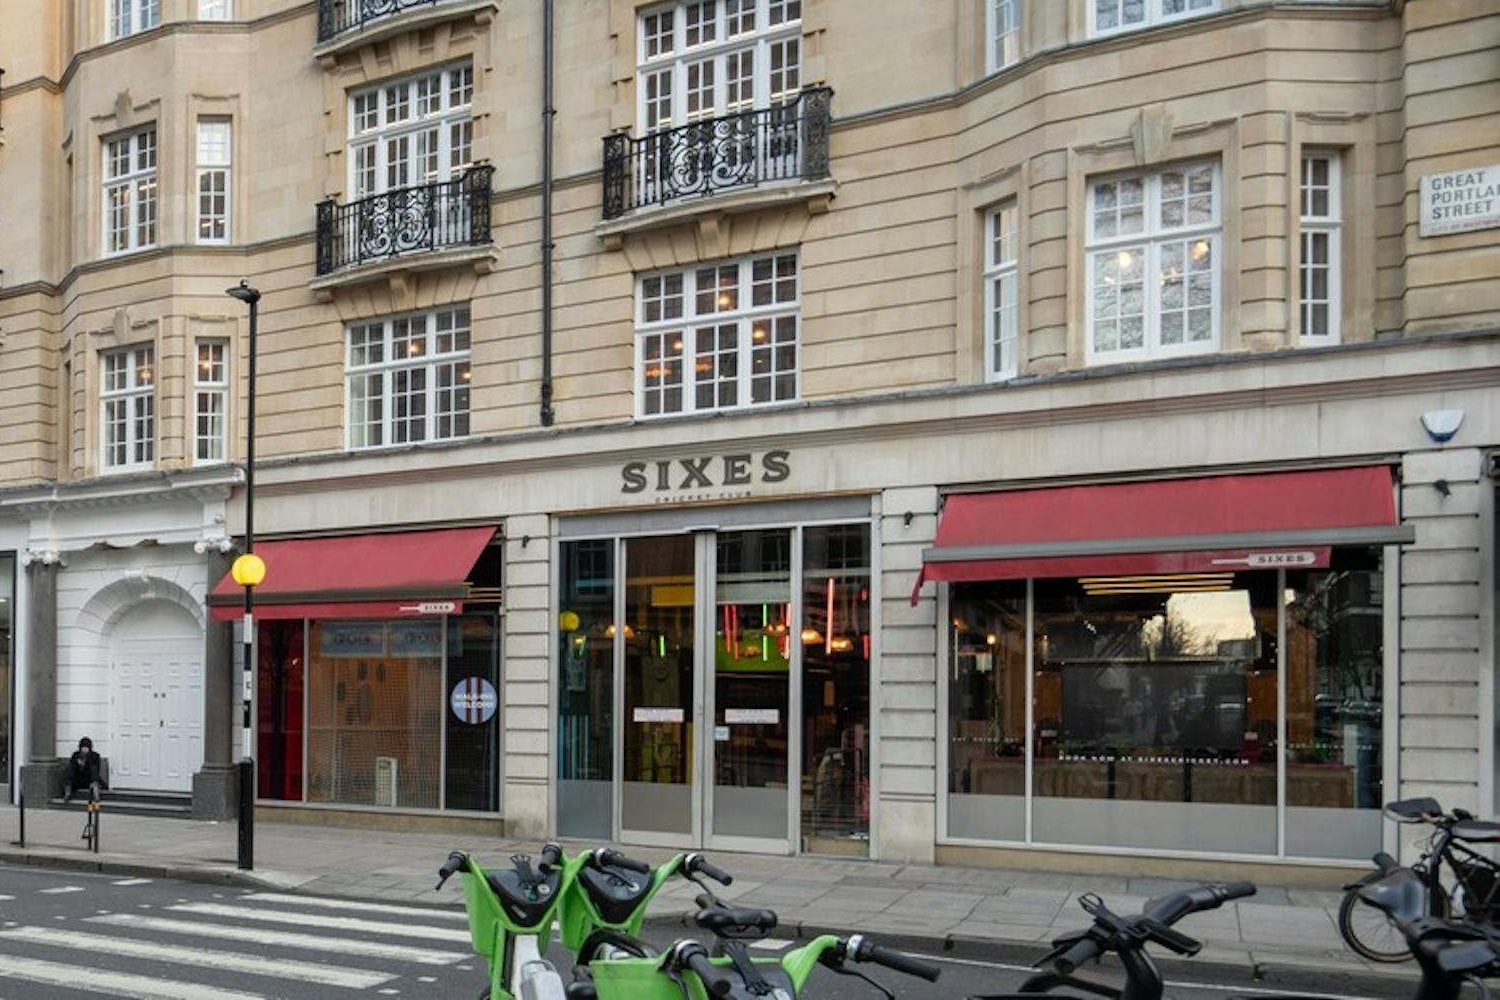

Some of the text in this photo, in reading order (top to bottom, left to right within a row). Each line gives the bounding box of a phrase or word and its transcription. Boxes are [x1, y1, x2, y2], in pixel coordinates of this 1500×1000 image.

[1431, 171, 1484, 190] GREAT
[1431, 200, 1493, 220] STREET
[621, 450, 791, 494] SIXES
[655, 491, 752, 504] CRICKET CLUB
[1258, 554, 1305, 564] SIXES
